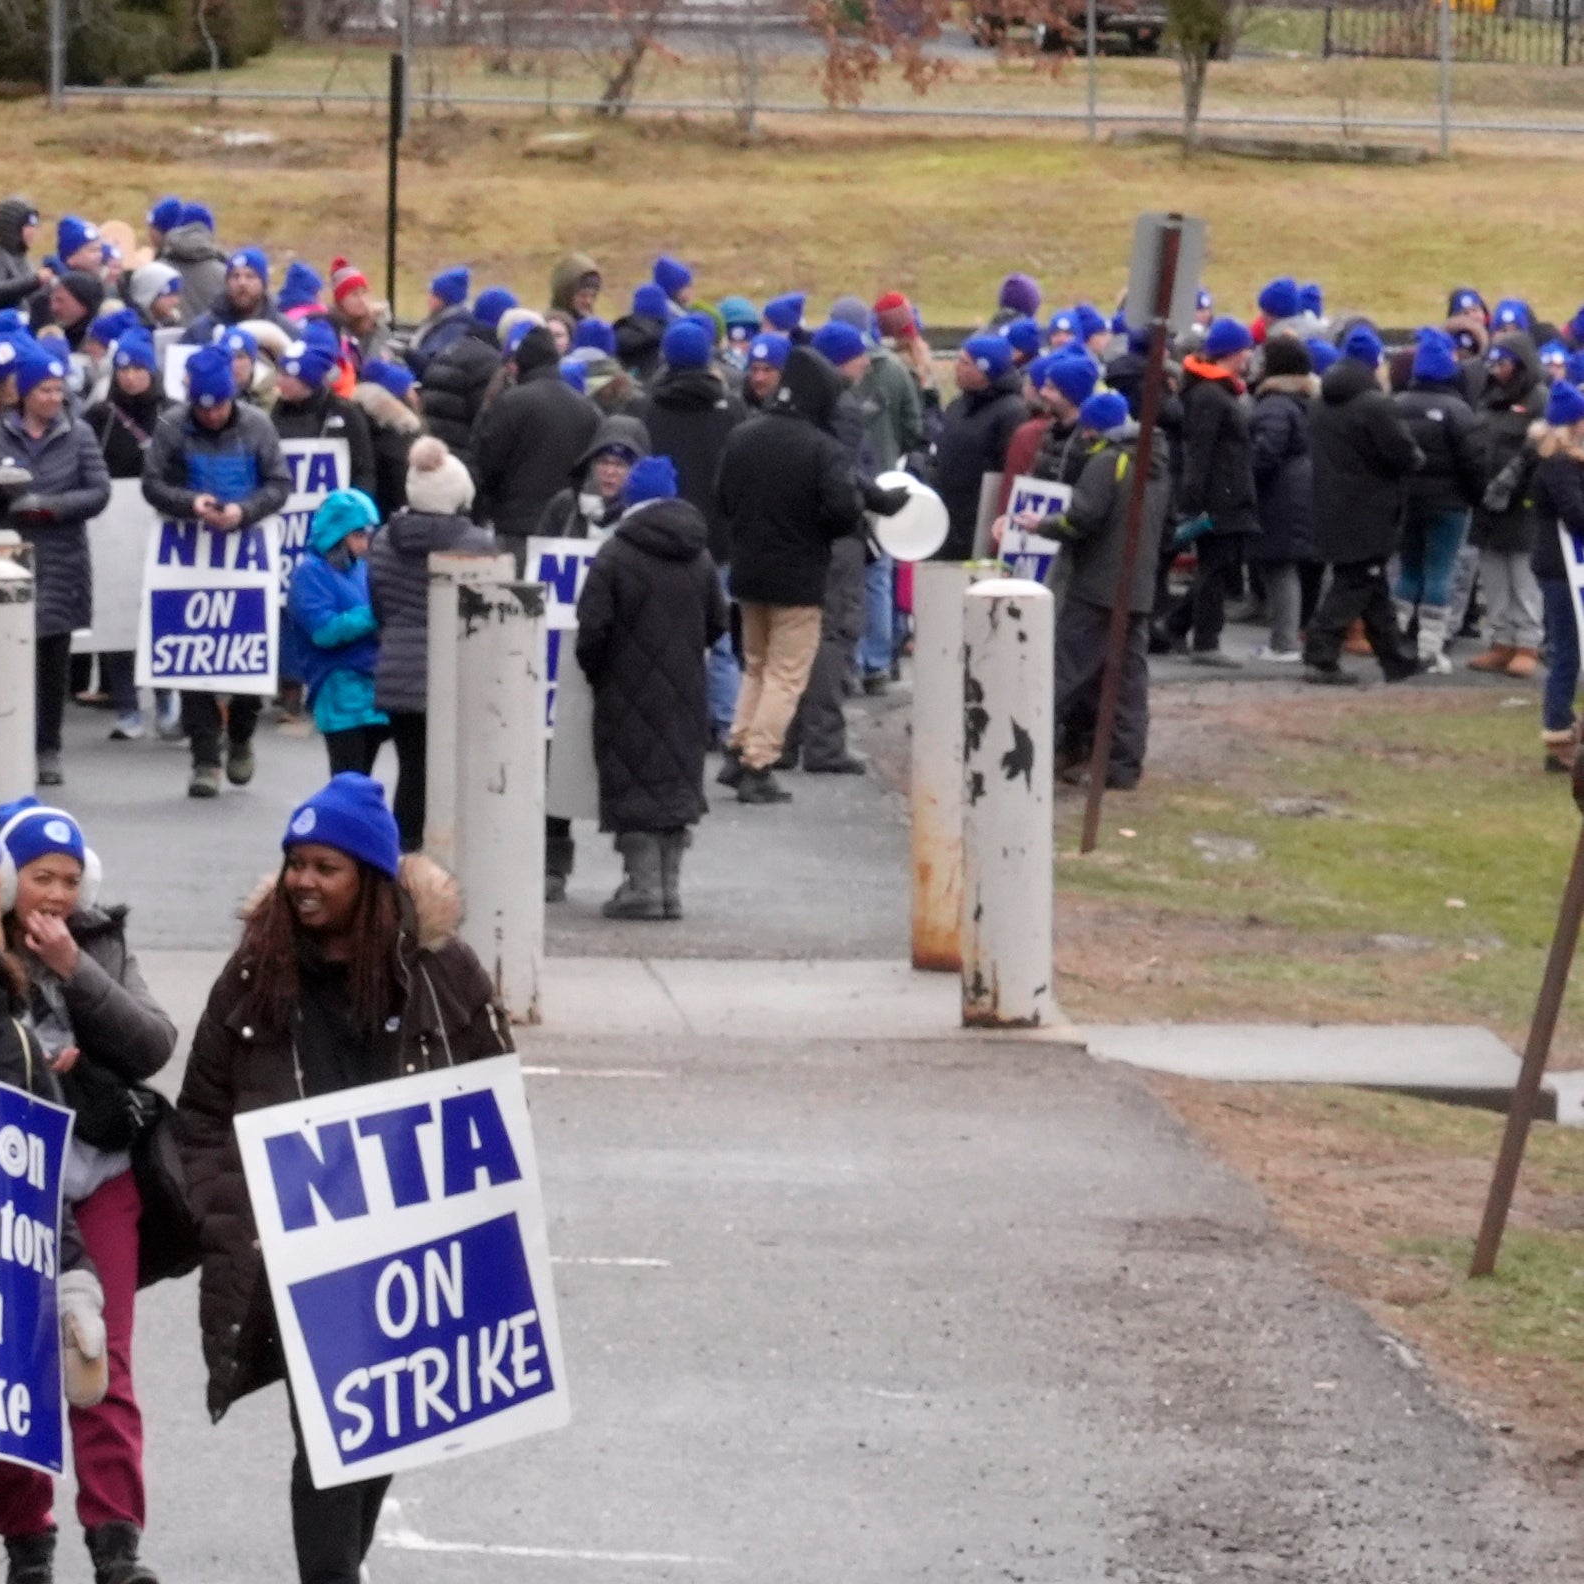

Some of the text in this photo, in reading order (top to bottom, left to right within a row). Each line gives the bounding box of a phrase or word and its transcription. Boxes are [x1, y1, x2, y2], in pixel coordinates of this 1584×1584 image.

[284, 453, 337, 494] TA
[158, 521, 269, 571] NTA
[184, 590, 237, 629] ON
[152, 633, 267, 674] STRIKE
[263, 1088, 523, 1232] NTA
[374, 1241, 465, 1339] ON
[334, 1309, 543, 1451] STRIKE
